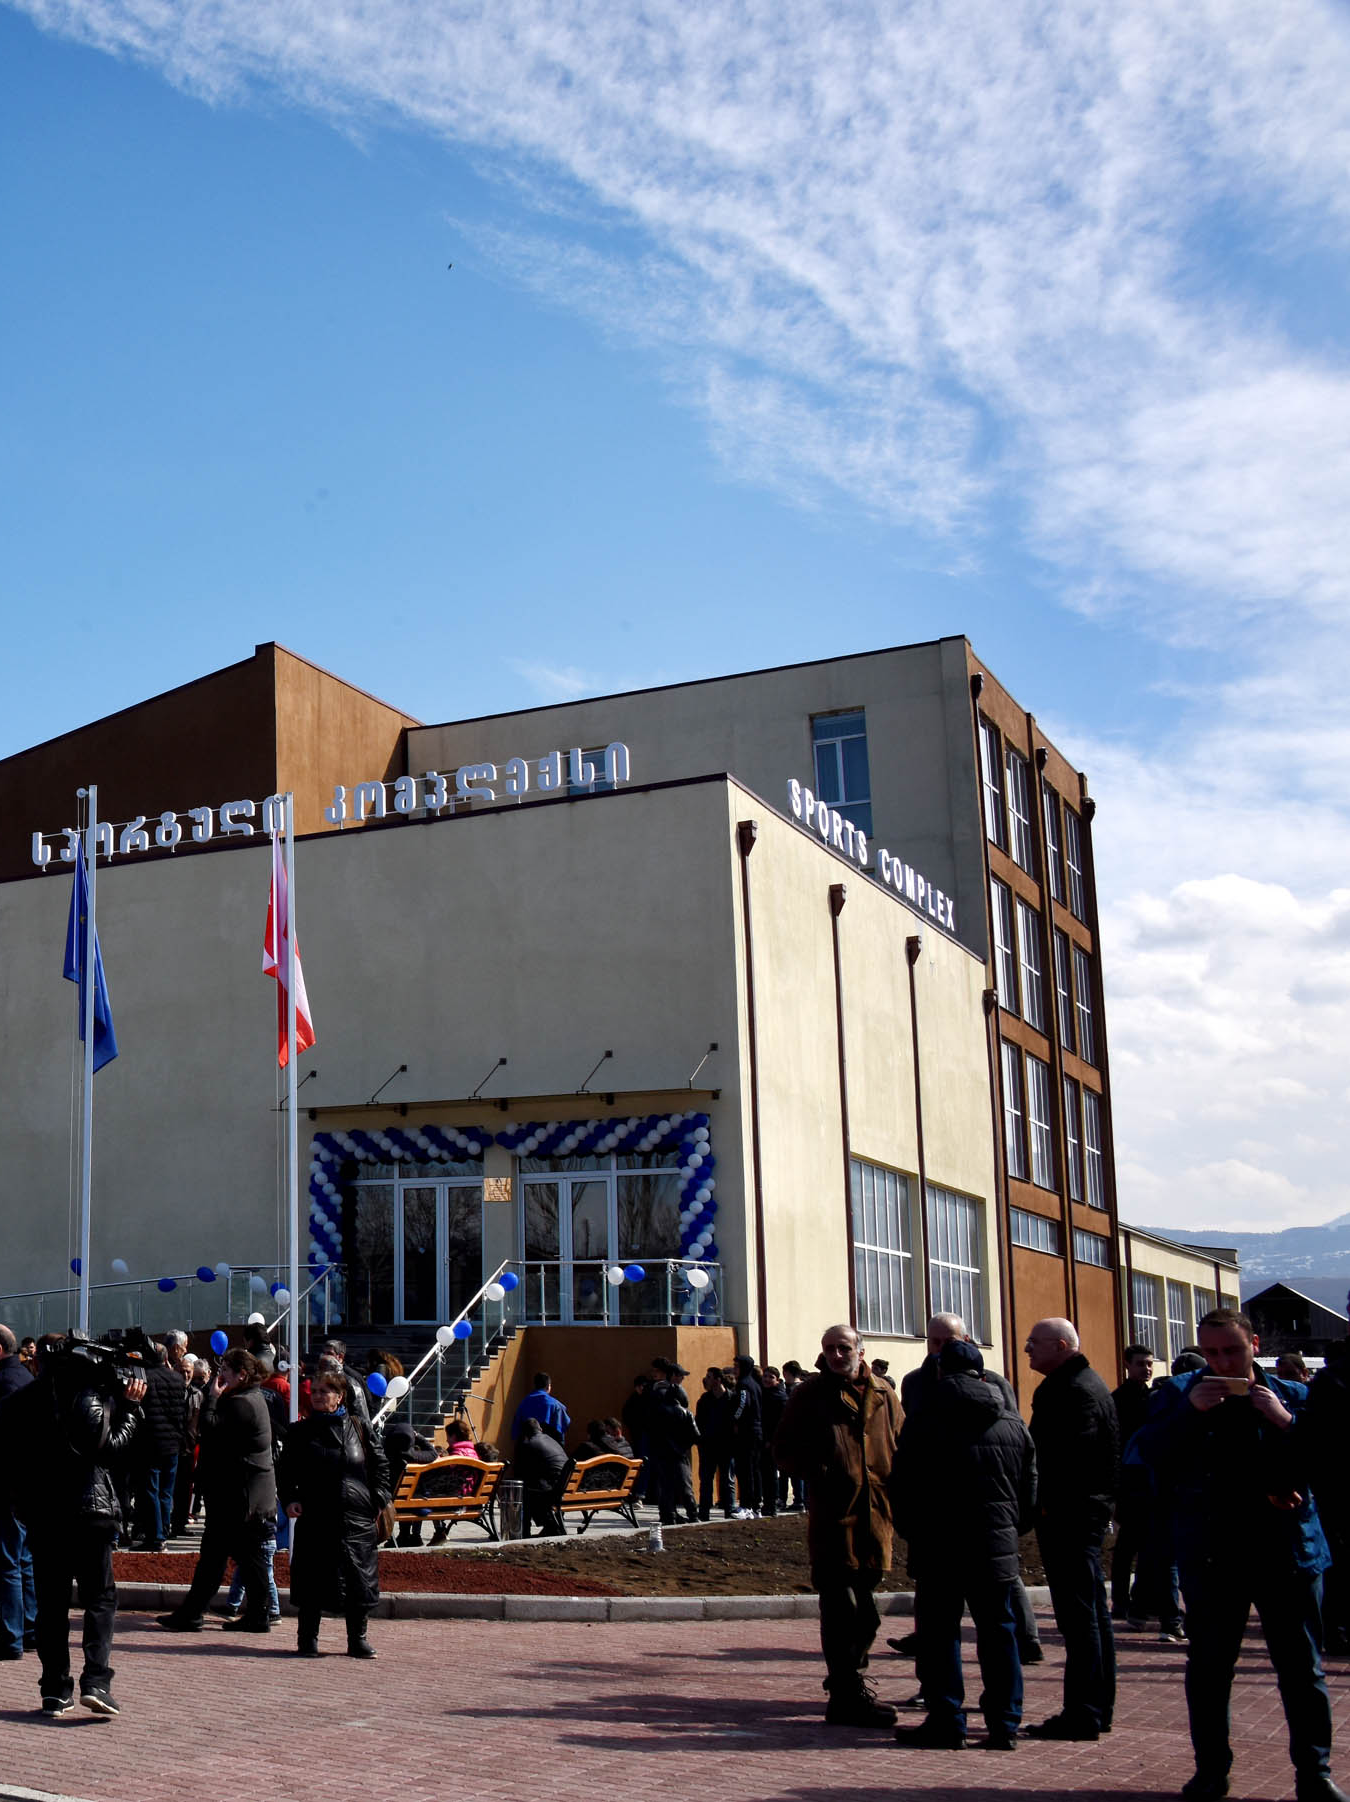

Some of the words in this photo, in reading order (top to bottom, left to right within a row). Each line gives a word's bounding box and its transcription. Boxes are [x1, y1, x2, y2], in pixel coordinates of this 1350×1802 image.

[324, 742, 630, 824] კომპლექსი
[787, 778, 868, 866] SPORTS
[878, 848, 955, 932] COMPLEX
